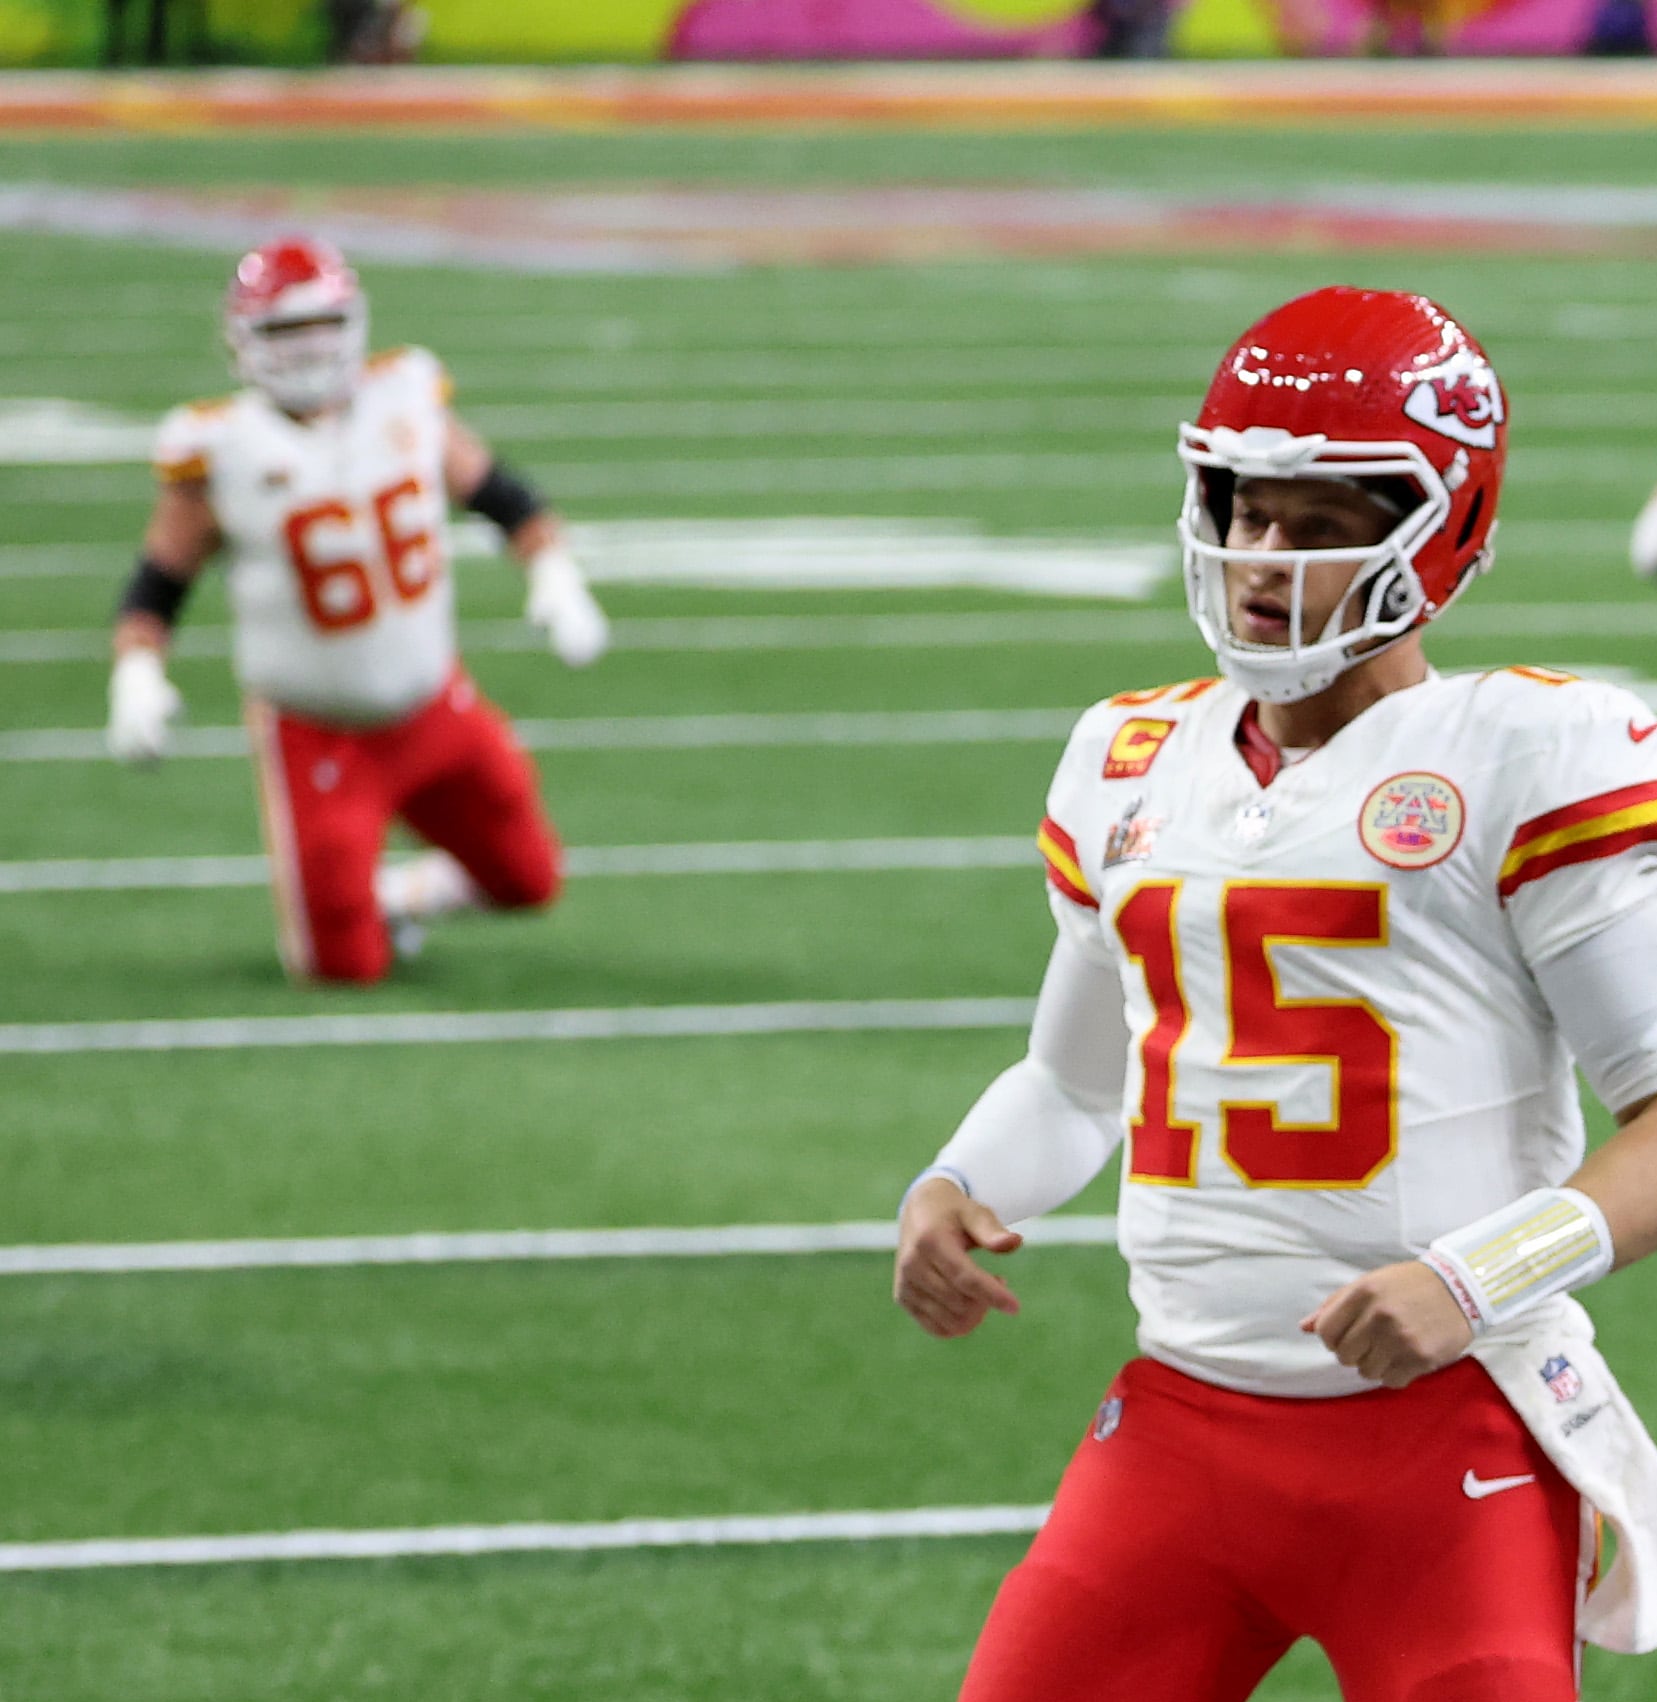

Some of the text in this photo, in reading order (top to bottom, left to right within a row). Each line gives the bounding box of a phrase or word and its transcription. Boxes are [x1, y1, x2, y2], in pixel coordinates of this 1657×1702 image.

[284, 478, 440, 634] 66
[1109, 719, 1170, 762] C
[1110, 878, 1399, 1190] 15
